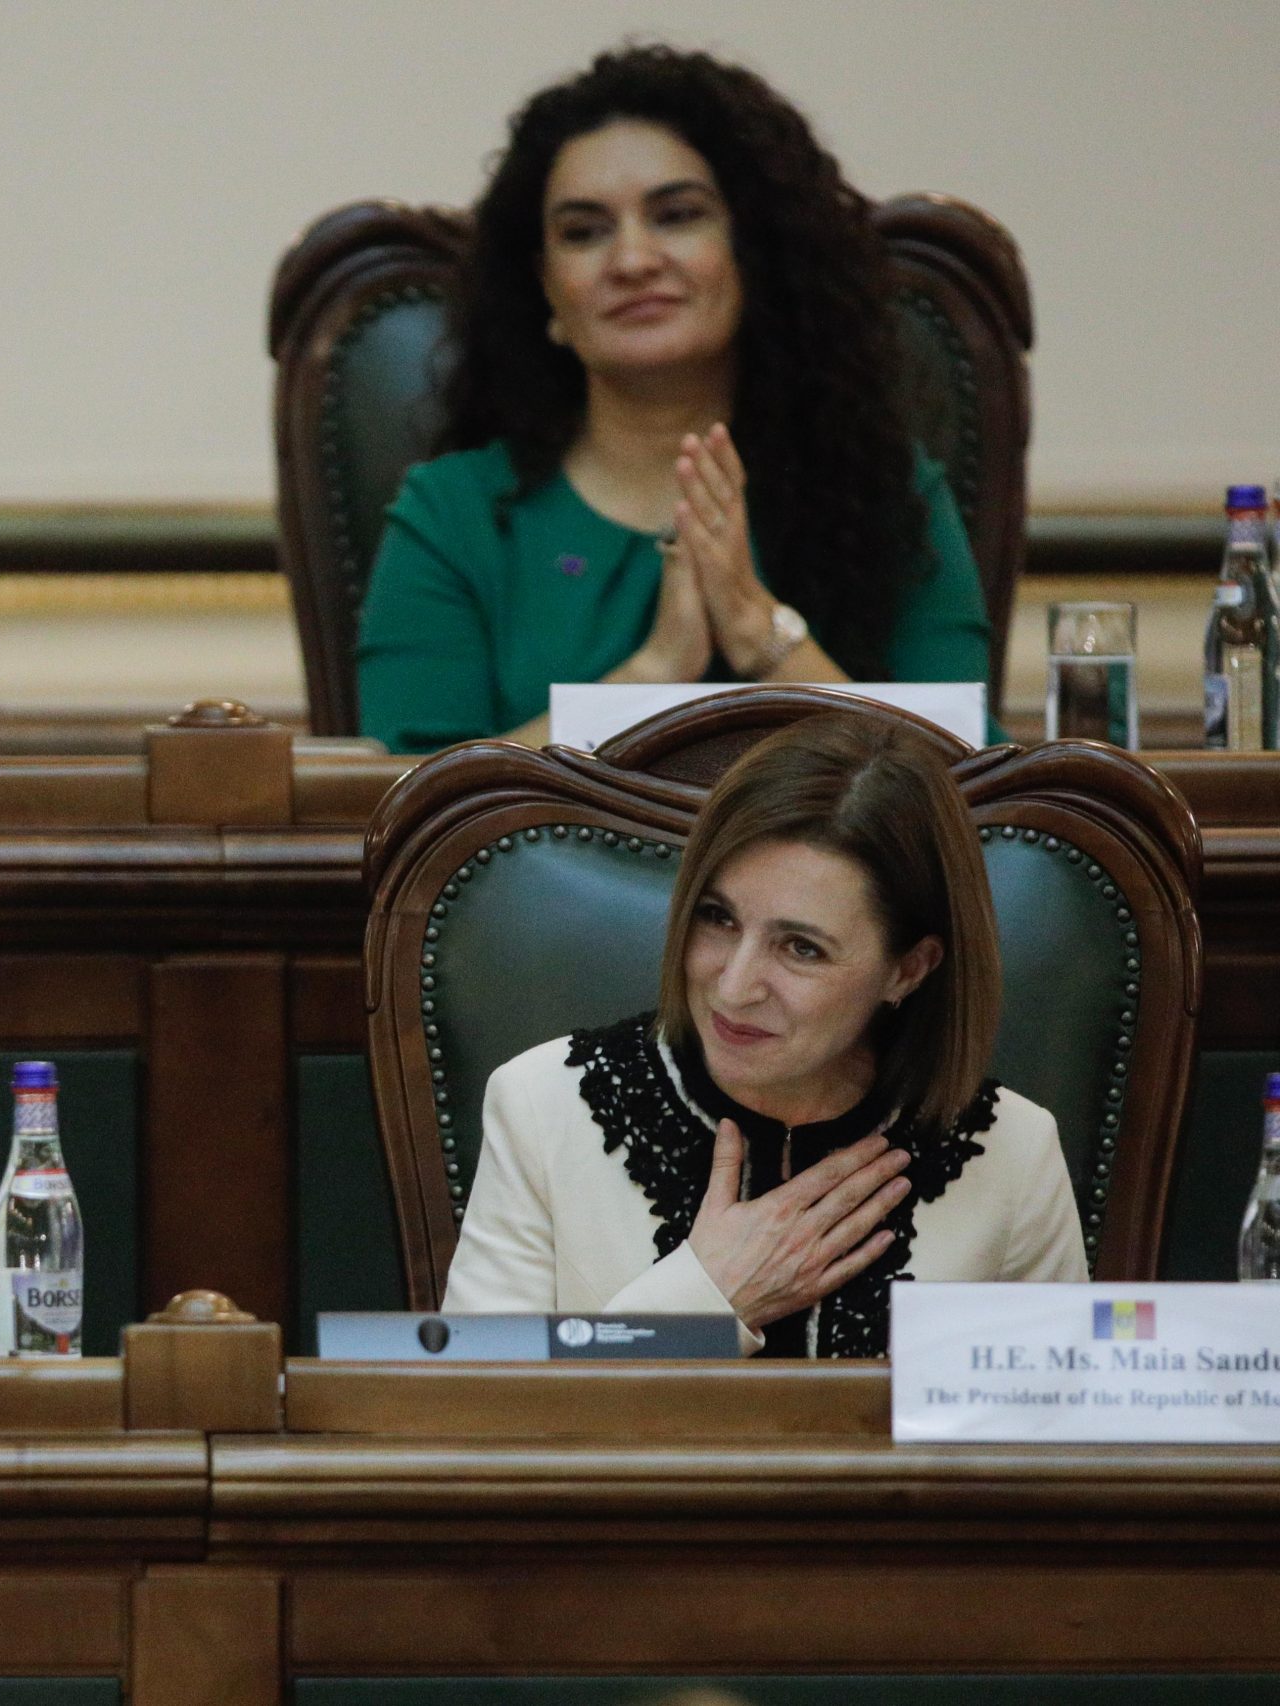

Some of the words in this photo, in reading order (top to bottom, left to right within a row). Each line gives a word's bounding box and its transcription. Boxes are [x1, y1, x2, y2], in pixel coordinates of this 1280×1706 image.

[970, 1345, 1036, 1371] H.E.
[1047, 1346, 1099, 1372] Ms.
[1111, 1346, 1187, 1372] Maia
[925, 1387, 960, 1405] The
[967, 1388, 1062, 1406] President
[1066, 1388, 1088, 1405] of
[1092, 1389, 1122, 1406] the
[1130, 1388, 1220, 1411] Republic
[1224, 1389, 1247, 1407] of
